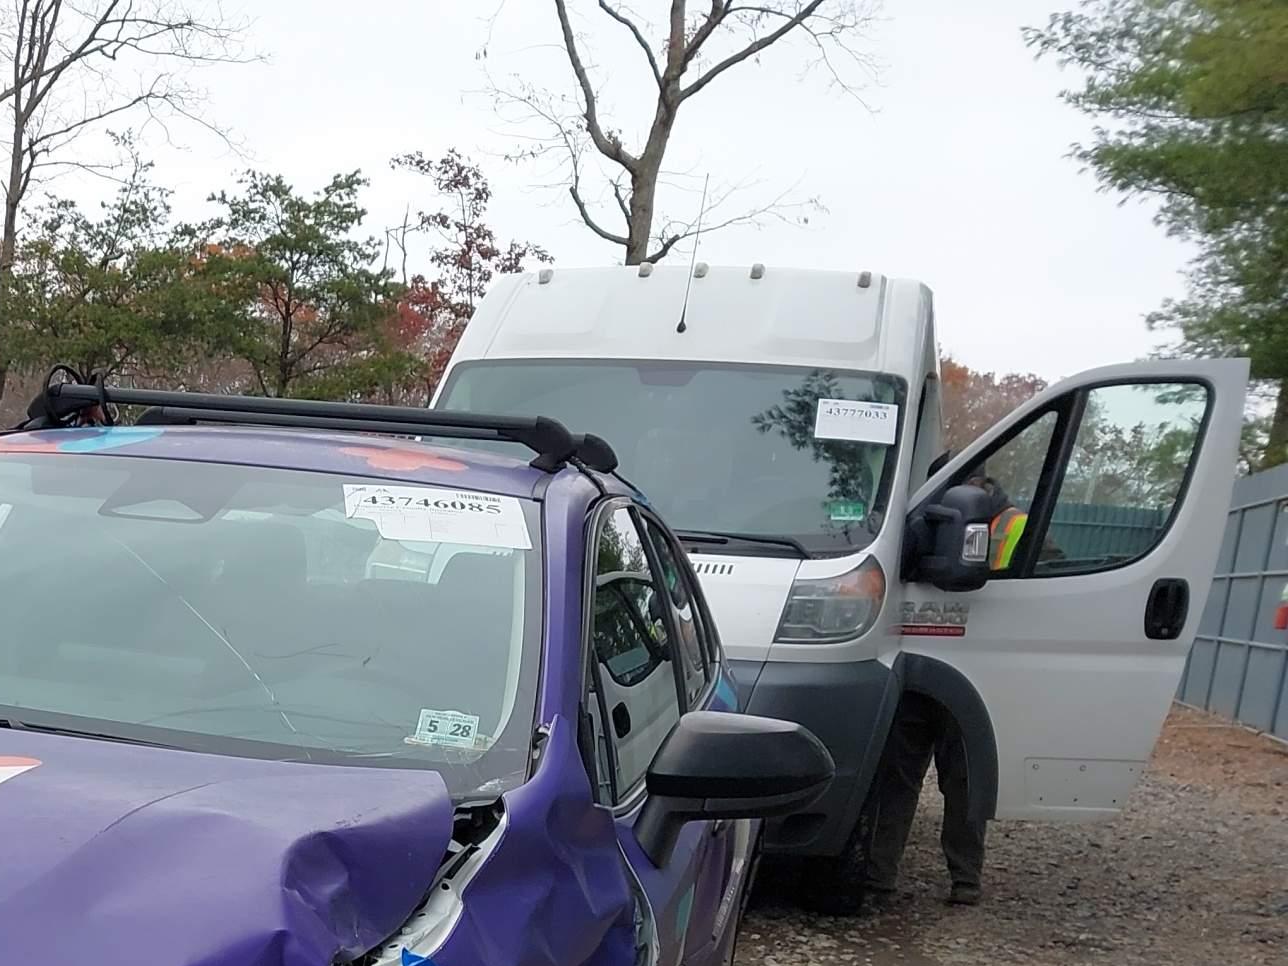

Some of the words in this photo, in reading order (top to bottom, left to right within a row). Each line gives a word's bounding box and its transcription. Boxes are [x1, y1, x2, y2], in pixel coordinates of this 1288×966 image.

[825, 407, 889, 420] 43777033
[362, 495, 503, 516] 43746085
[427, 719, 440, 733] 5
[449, 723, 472, 738] 28
